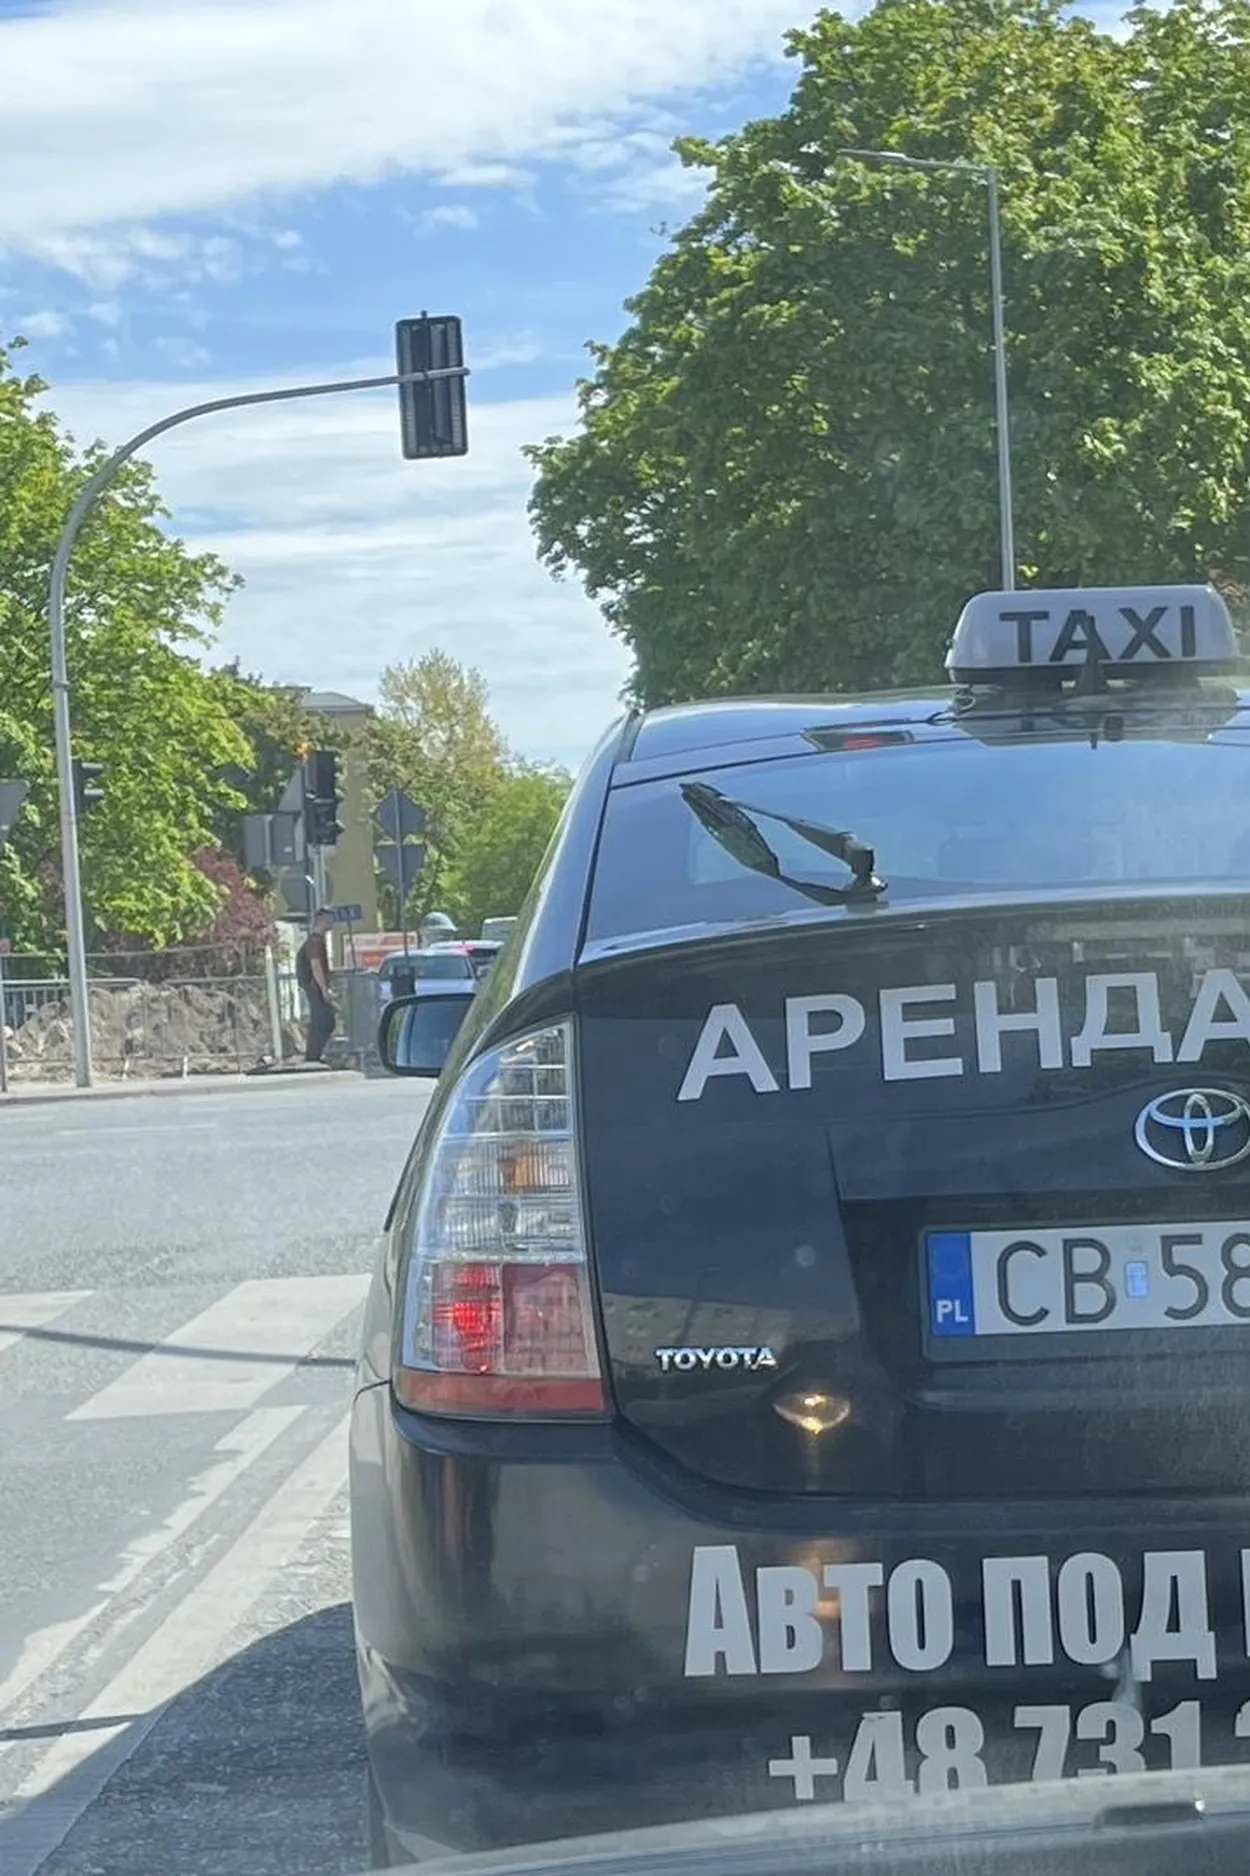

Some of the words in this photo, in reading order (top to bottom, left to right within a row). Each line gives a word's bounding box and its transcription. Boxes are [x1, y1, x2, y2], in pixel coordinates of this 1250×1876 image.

[999, 605, 1196, 663] TAXI
[936, 1299, 968, 1324] PL
[996, 1238, 1117, 1326] CB
[656, 1347, 778, 1371] TOYOTA
[684, 1544, 953, 1677] Авто
[983, 1550, 1217, 1682] под
[768, 1706, 988, 1801] +48
